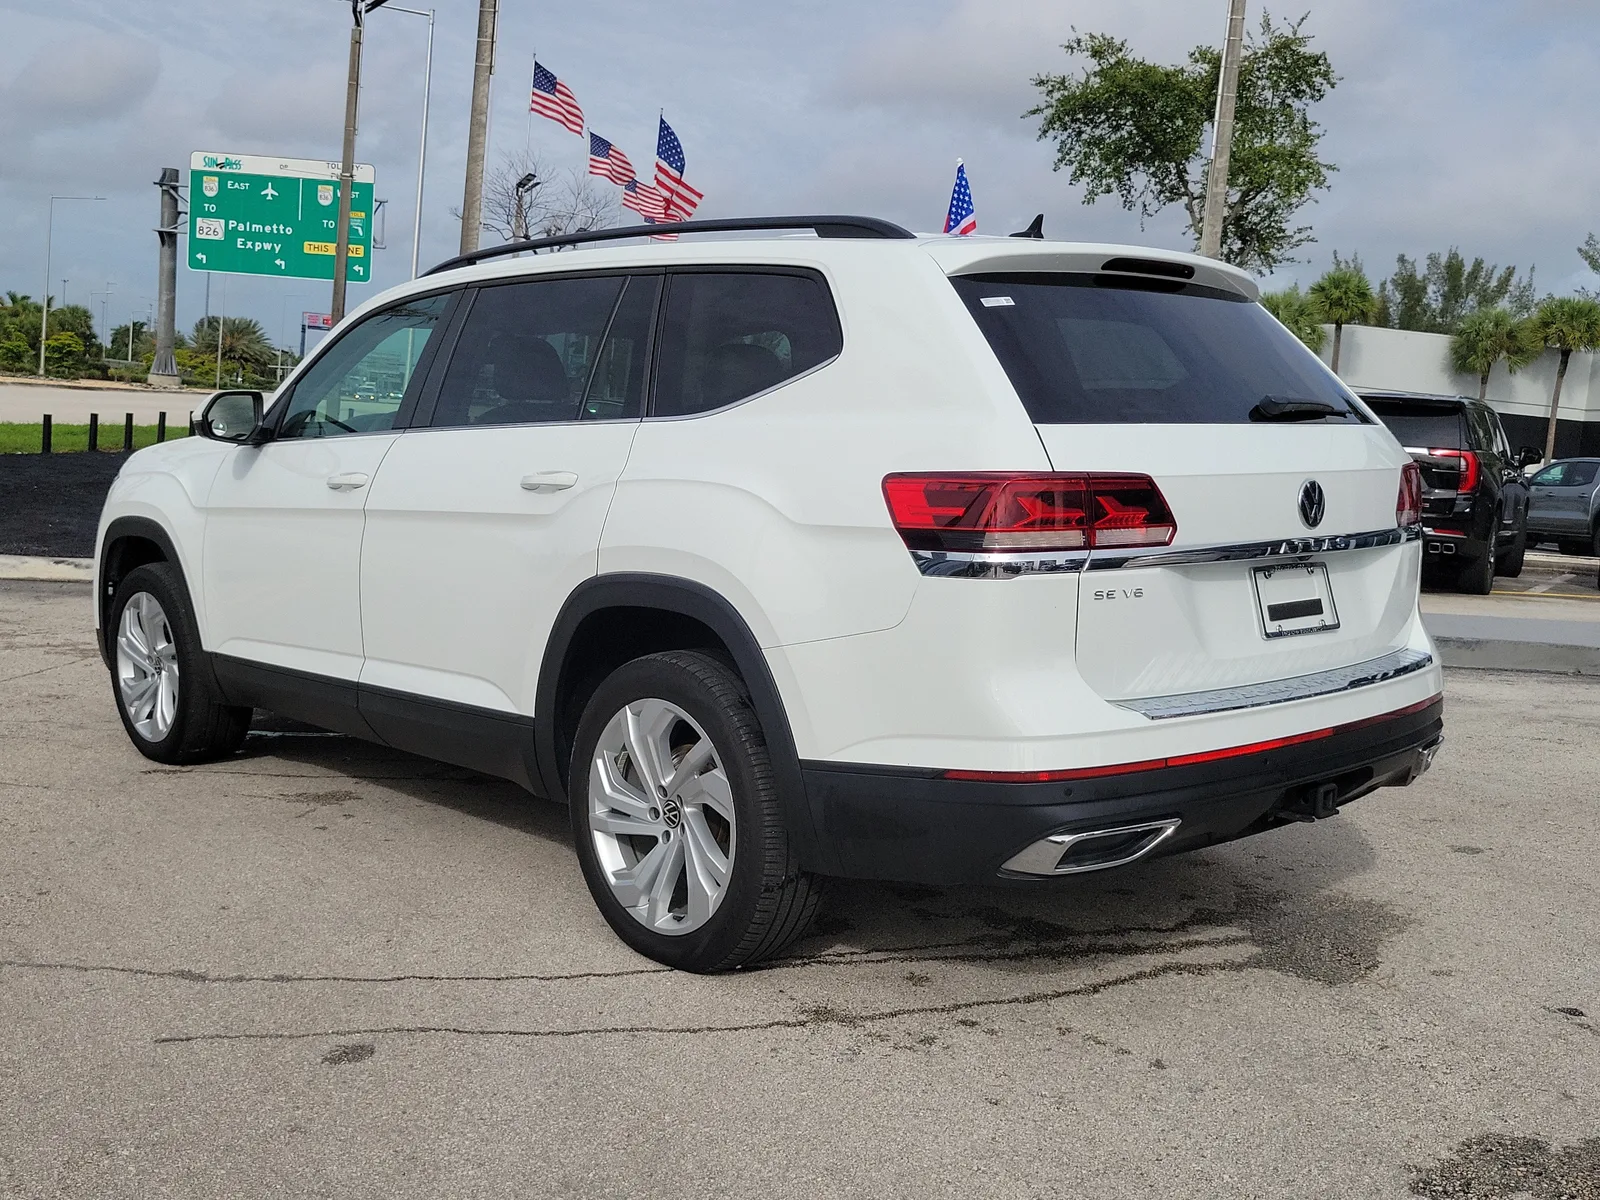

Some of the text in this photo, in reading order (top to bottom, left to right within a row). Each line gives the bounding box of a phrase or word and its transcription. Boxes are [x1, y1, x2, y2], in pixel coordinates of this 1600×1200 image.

[227, 180, 250, 190] EAST
[204, 203, 217, 213] TO
[228, 220, 293, 235] Palmetto
[322, 219, 335, 229] TO
[198, 226, 219, 236] 826
[237, 238, 281, 254] Expwy
[307, 243, 361, 255] THIS NE
[1093, 588, 1144, 601] SE V6
